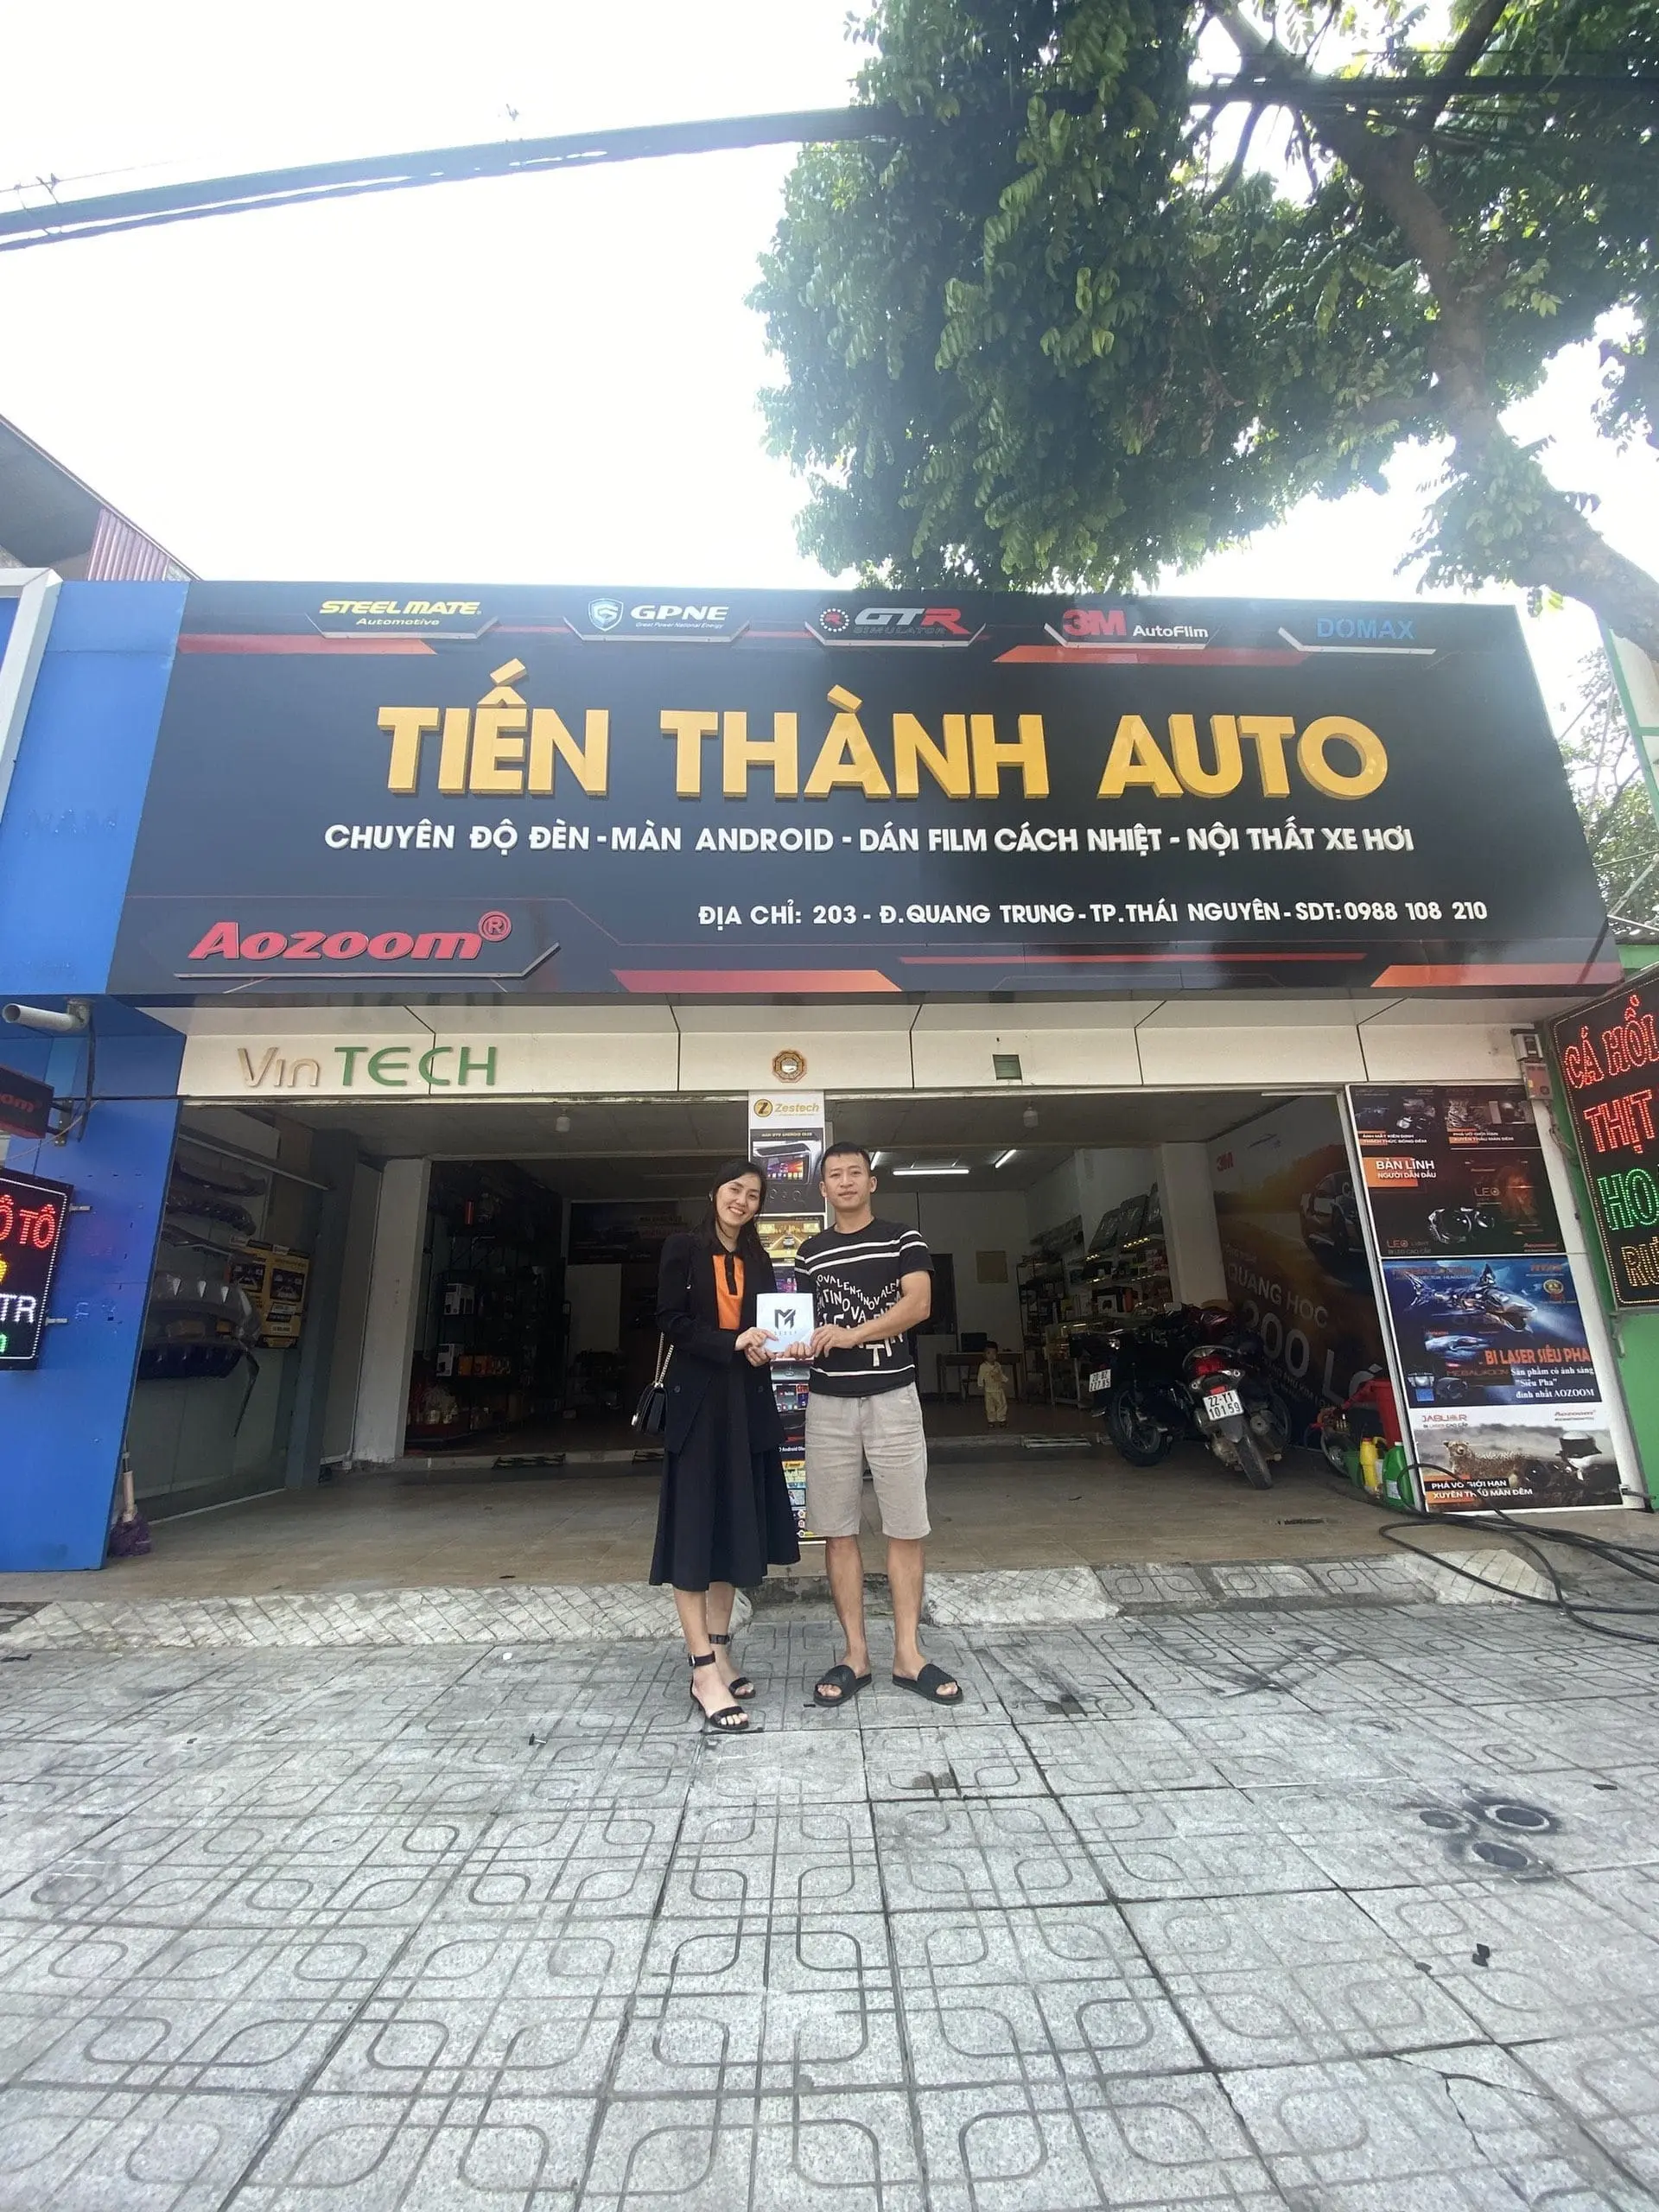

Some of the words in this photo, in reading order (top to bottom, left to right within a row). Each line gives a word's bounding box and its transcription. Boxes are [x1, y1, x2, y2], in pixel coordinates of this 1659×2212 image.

[630, 605, 729, 620] GPNE
[855, 607, 971, 634] GTR
[1063, 608, 1127, 636] 3M
[1317, 618, 1414, 639] DOMAX
[377, 658, 610, 797] TIẾN
[659, 684, 1050, 800] THÀNH
[1097, 713, 1389, 800] AUTO
[324, 819, 455, 850] CHUYÊN
[469, 818, 518, 855] ĐỘ
[528, 818, 589, 850] ĐÈN
[611, 819, 681, 851] MÀN
[695, 828, 834, 851] ANDROID
[860, 821, 919, 851] DÁN
[928, 828, 988, 851] FILM
[994, 821, 1078, 852] CÁCH
[1087, 823, 1162, 857] NHIỆT
[1186, 821, 1239, 856] NỘI
[1246, 816, 1315, 851] THẤT
[1321, 827, 1358, 851] XE
[1362, 824, 1414, 851] HƠI
[698, 905, 742, 931] ĐỊA
[750, 899, 802, 925] CHỈ:
[813, 905, 857, 925] 203
[999, 904, 1075, 924] TRUNG
[1187, 898, 1281, 922] NGUYÊN
[1404, 901, 1442, 920] 108
[1452, 901, 1488, 920] 210
[188, 921, 482, 960] Aozoom
[237, 1047, 321, 1087] Vin
[334, 1046, 496, 1086] TECH
[1564, 1026, 1605, 1089] CÁ
[775, 1103, 819, 1113] Zestech
[1583, 1089, 1655, 1154] THỊT
[1376, 1158, 1402, 1170] BẢN
[1484, 1350, 1498, 1365] BI
[1499, 1349, 1535, 1364] LASER
[1208, 1392, 1234, 1408] 22-Y1
[1554, 1388, 1595, 1397] AOZOOM
[1433, 1490, 1463, 1498] XUYÊN
